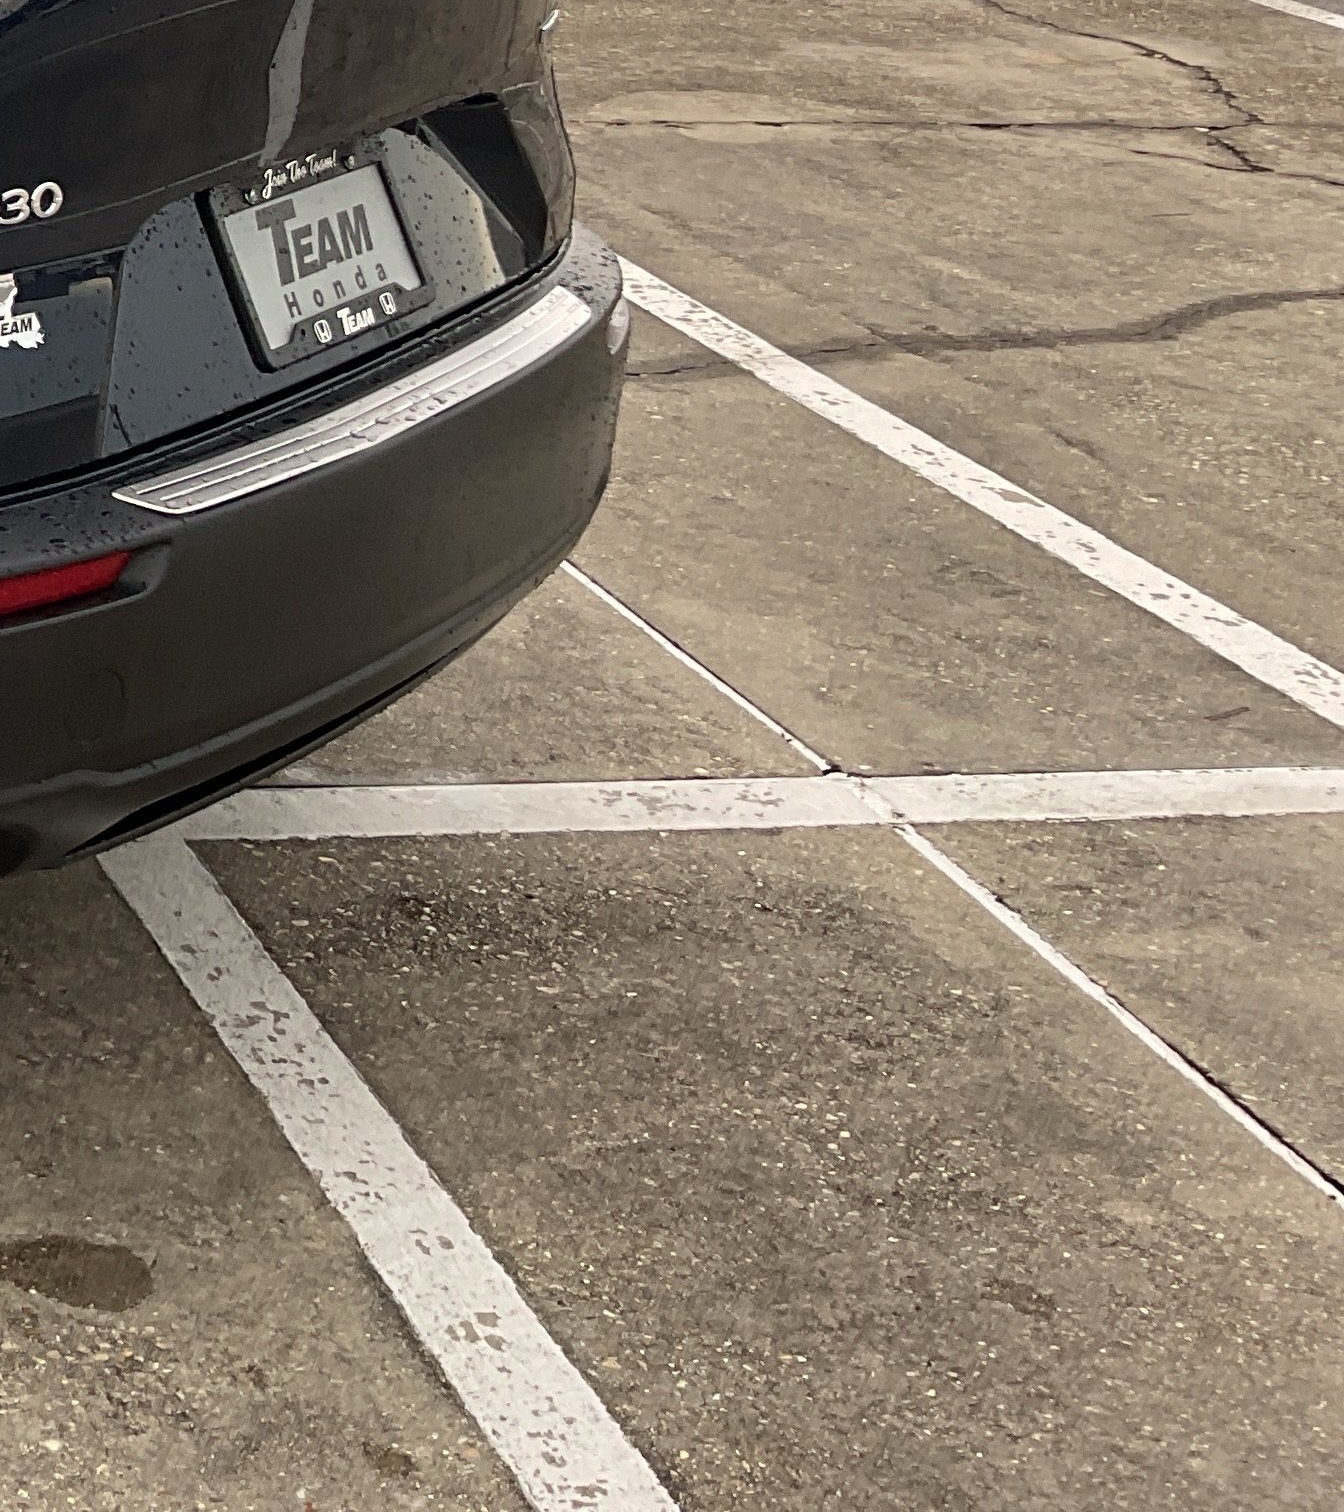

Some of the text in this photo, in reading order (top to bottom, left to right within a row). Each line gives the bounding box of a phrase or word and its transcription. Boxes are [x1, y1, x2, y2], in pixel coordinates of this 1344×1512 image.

[262, 168, 288, 199] Join
[285, 160, 307, 184] The
[255, 198, 374, 287] TEAM
[284, 262, 388, 319] Honda
[337, 307, 376, 336] TEAM
